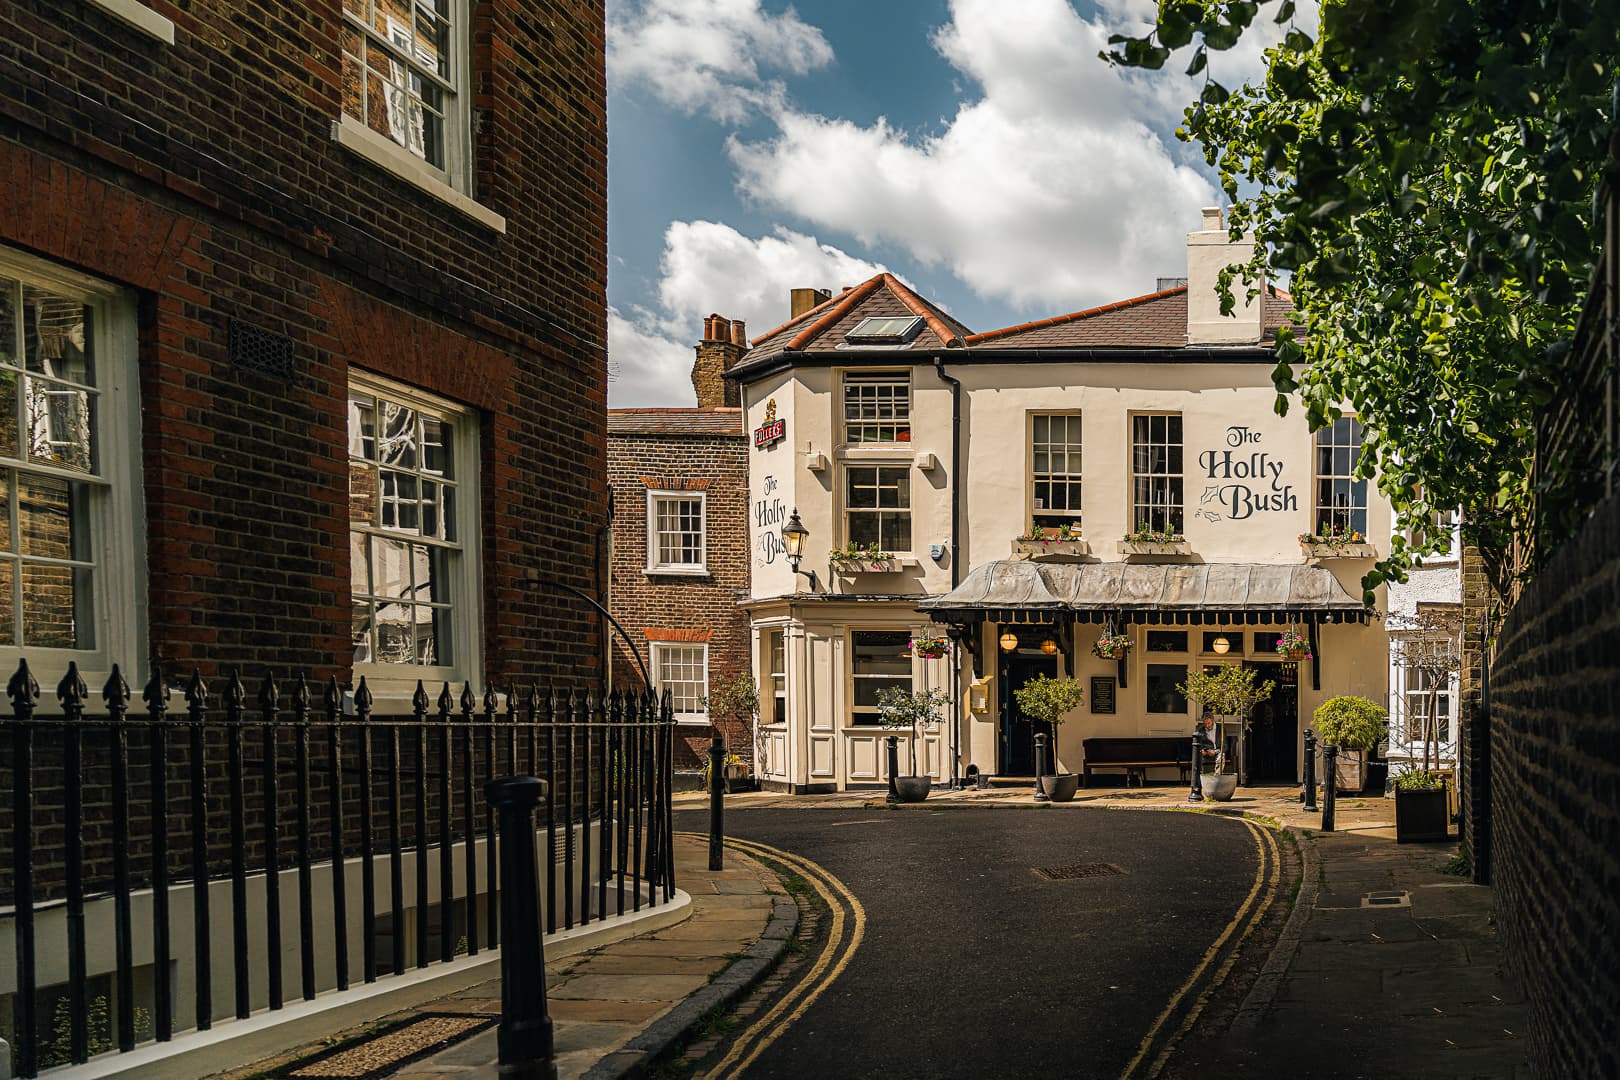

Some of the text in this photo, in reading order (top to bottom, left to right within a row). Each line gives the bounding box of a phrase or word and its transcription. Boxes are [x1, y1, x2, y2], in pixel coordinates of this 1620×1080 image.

[1227, 426, 1262, 447] The
[764, 475, 777, 496] The
[1199, 451, 1284, 491] Holly
[755, 499, 786, 533] Holly
[1219, 485, 1298, 519] Bush
[762, 531, 787, 564] Bus
